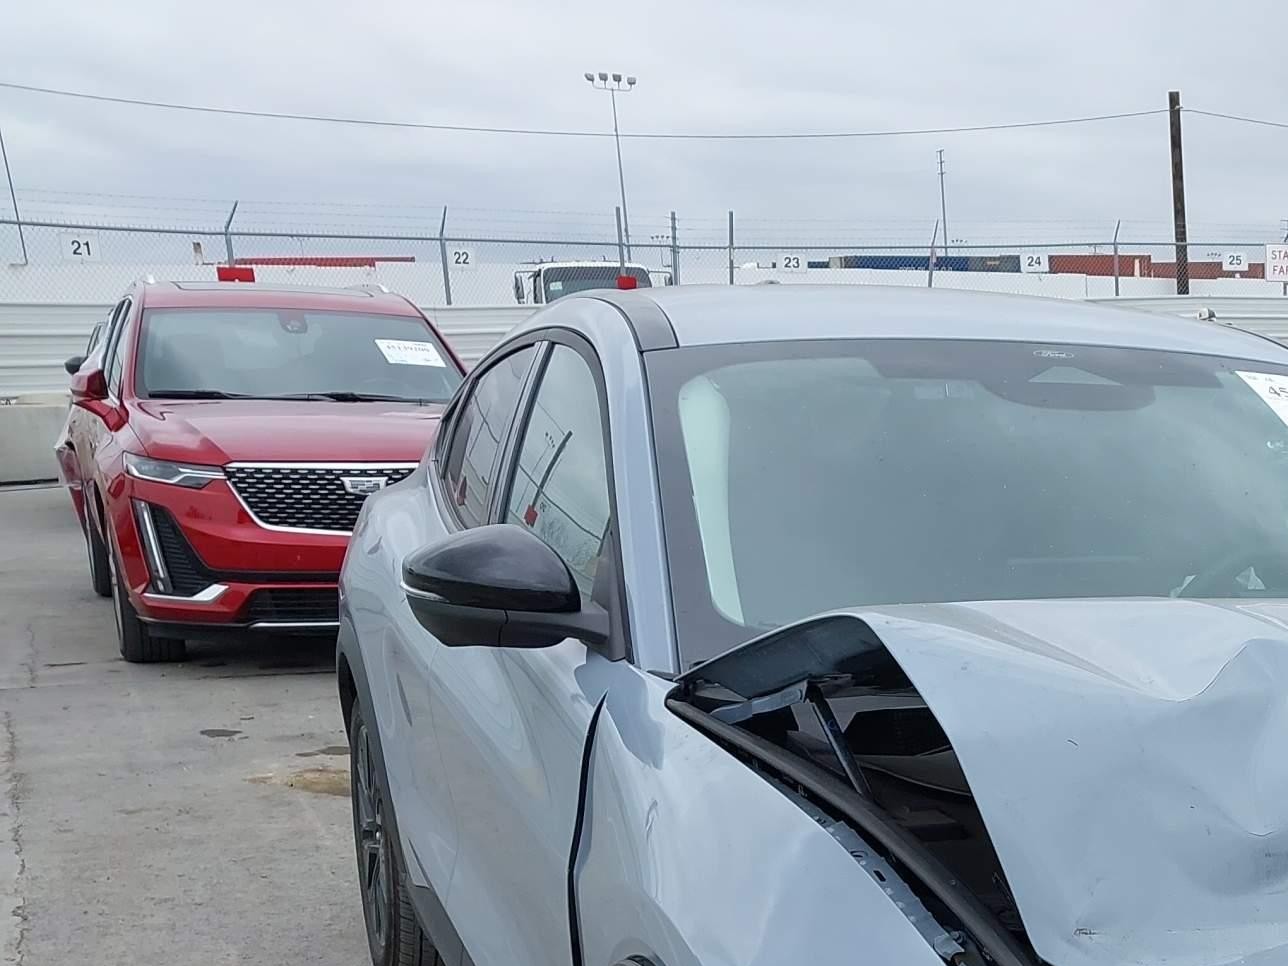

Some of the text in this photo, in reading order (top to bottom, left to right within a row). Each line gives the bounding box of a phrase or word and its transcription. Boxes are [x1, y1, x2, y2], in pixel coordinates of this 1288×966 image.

[71, 239, 91, 256] 21
[453, 251, 470, 265] 22
[783, 256, 800, 269] 23
[1027, 255, 1042, 267] 24
[1228, 255, 1242, 266] 25
